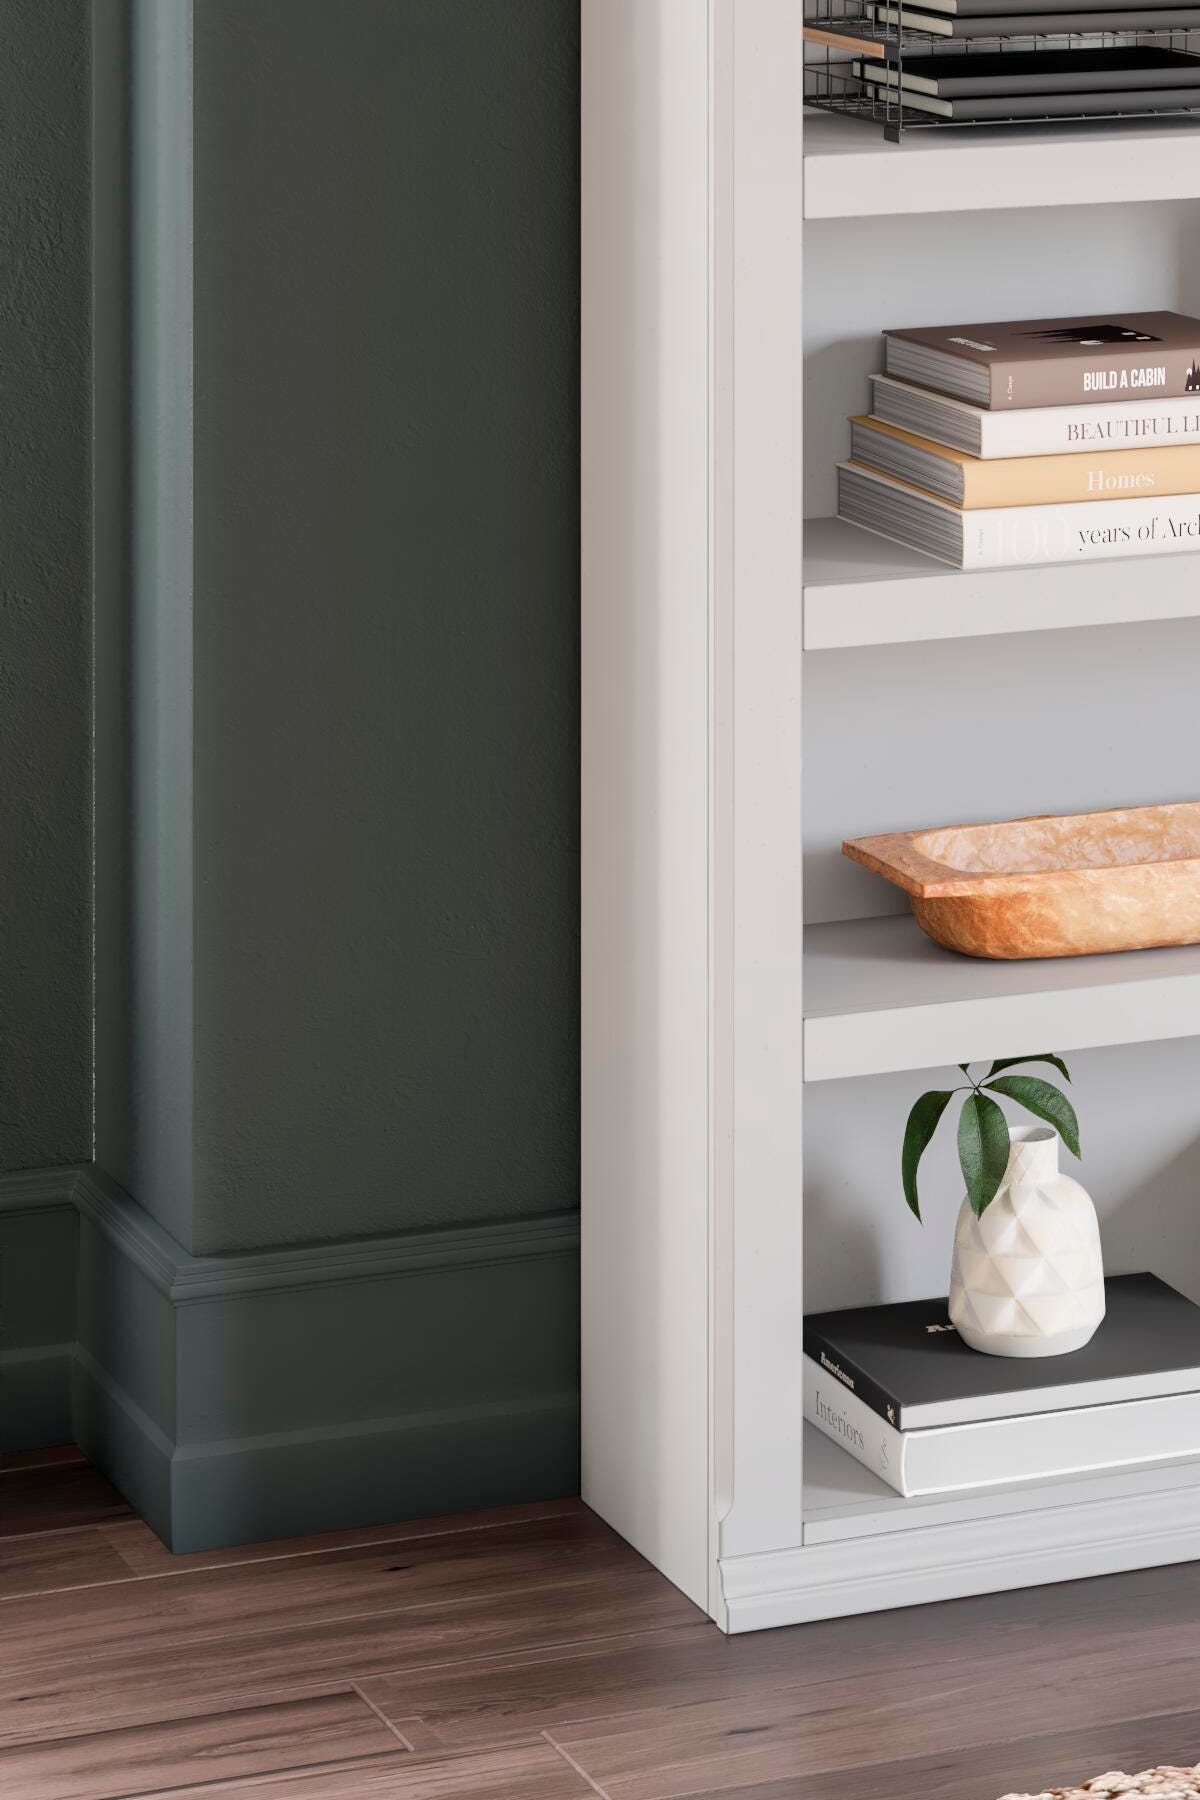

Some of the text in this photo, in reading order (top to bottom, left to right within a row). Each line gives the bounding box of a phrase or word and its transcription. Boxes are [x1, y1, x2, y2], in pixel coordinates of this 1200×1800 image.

[1083, 367, 1166, 391] BUILD A CABIN
[1067, 417, 1178, 441] BEAUTIFUL
[1088, 470, 1155, 492] Homes
[995, 516, 1070, 563] 100
[1078, 524, 1131, 552] years
[1137, 516, 1159, 541] of
[820, 1351, 855, 1390] Americana
[815, 1390, 865, 1450] Interiors
